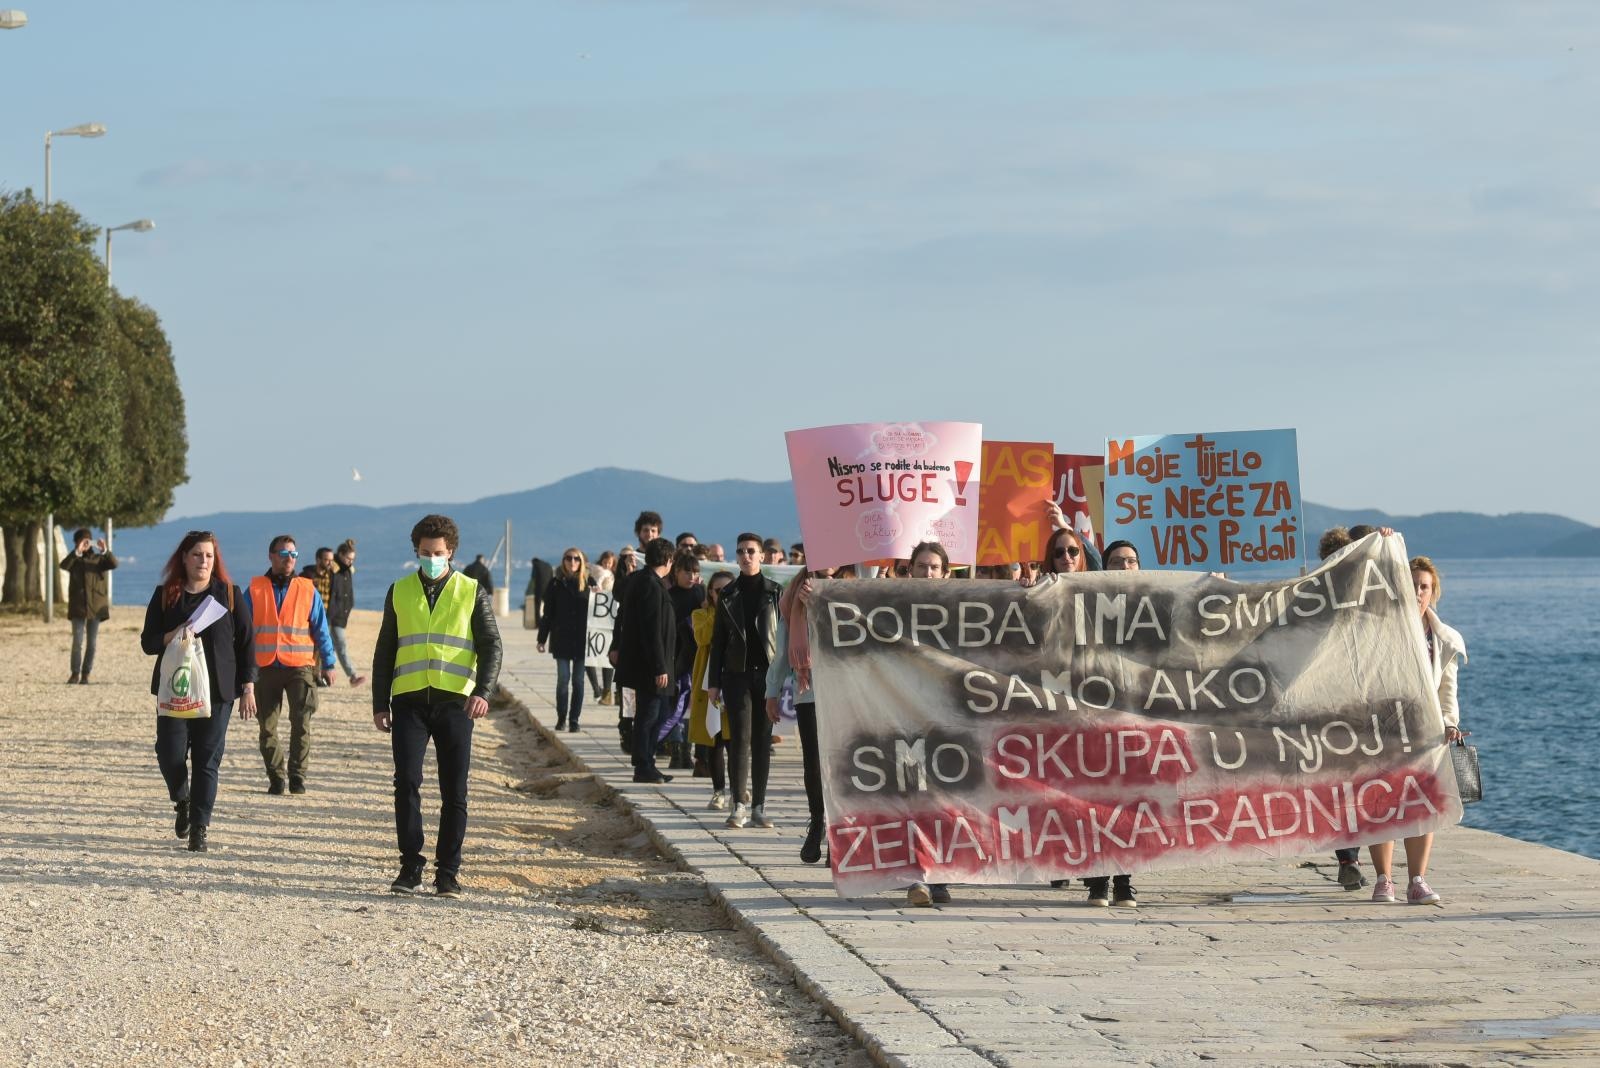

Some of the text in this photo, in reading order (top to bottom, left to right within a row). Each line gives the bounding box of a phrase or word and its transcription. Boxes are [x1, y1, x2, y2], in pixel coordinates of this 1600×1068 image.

[827, 456, 865, 478] Nismo
[870, 459, 882, 472] se
[913, 459, 923, 471] da
[837, 473, 939, 507] SLUGE
[1115, 480, 1292, 525] SE NEĆE ZA
[976, 519, 1040, 564] AM
[1151, 516, 1297, 566] VAS Predati
[828, 558, 1398, 650] BORBA IMA SMISLA
[963, 667, 1268, 714] SAMO AKO
[851, 737, 970, 792] SMO
[997, 730, 1193, 779] SKUPA
[1209, 731, 1248, 770] U
[836, 816, 993, 874] ŽENA,
[1183, 775, 1440, 846] RADNICA
